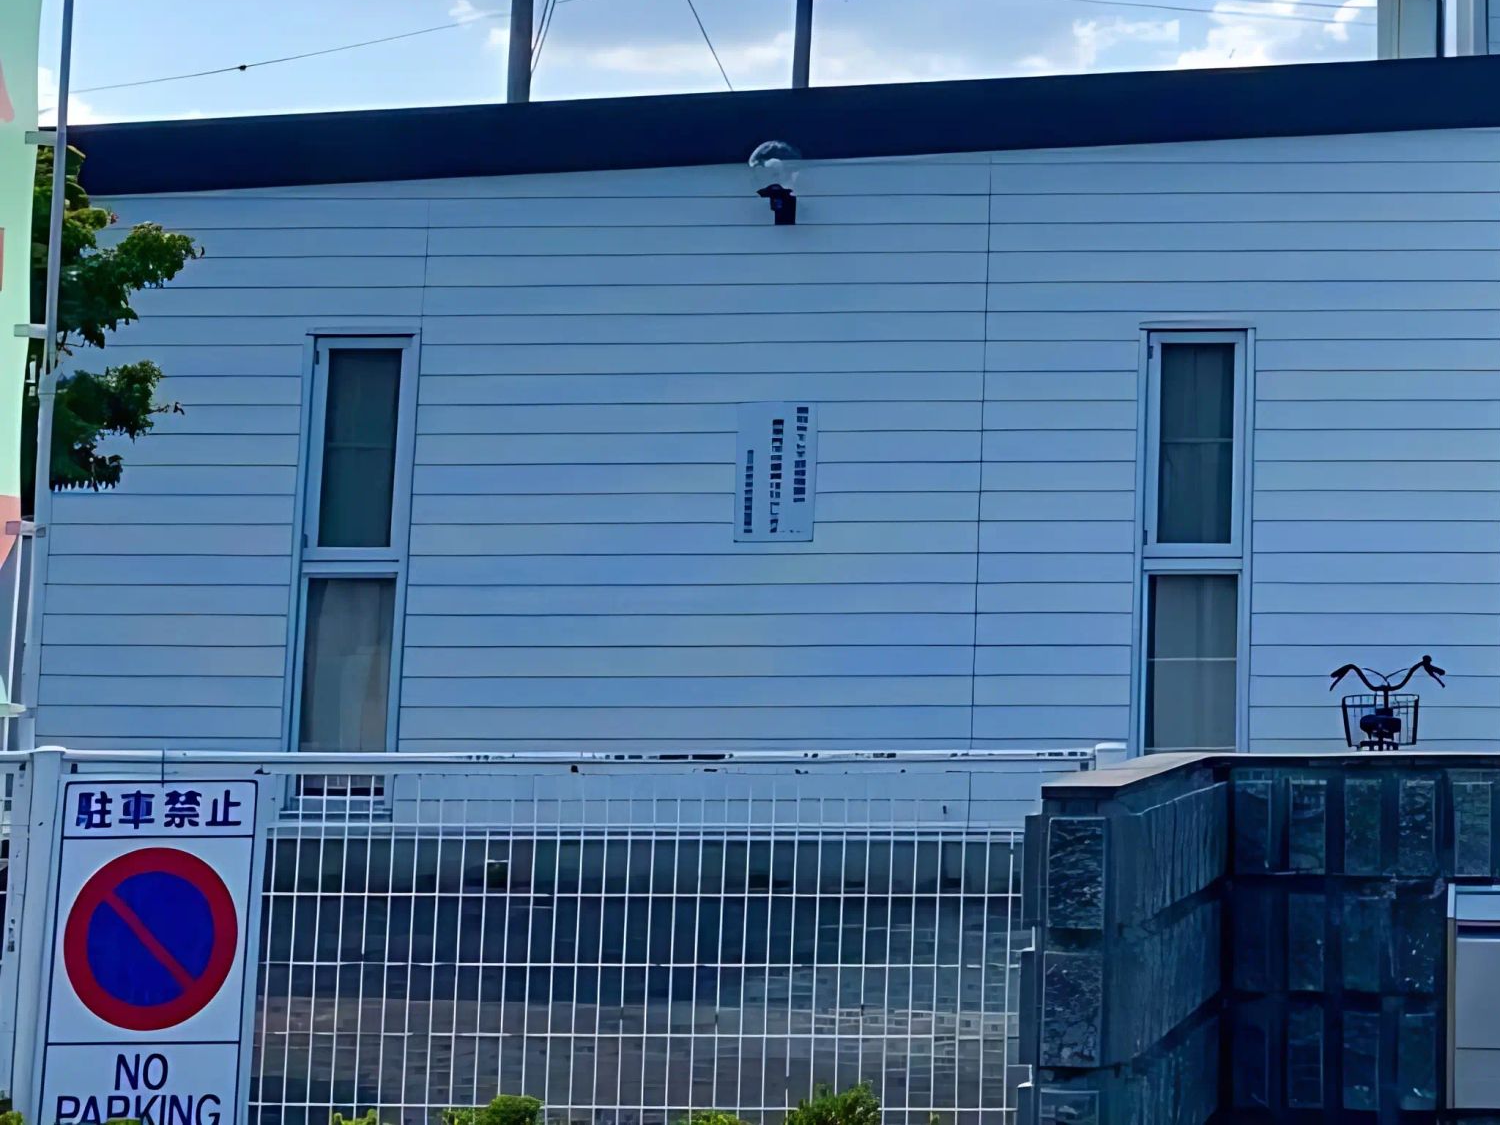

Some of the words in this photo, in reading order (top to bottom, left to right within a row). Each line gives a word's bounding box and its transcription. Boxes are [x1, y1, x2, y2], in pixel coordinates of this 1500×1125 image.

[76, 789, 242, 829] 駐車禁止
[114, 1053, 168, 1091] NO
[55, 1094, 221, 1125] PARKING
